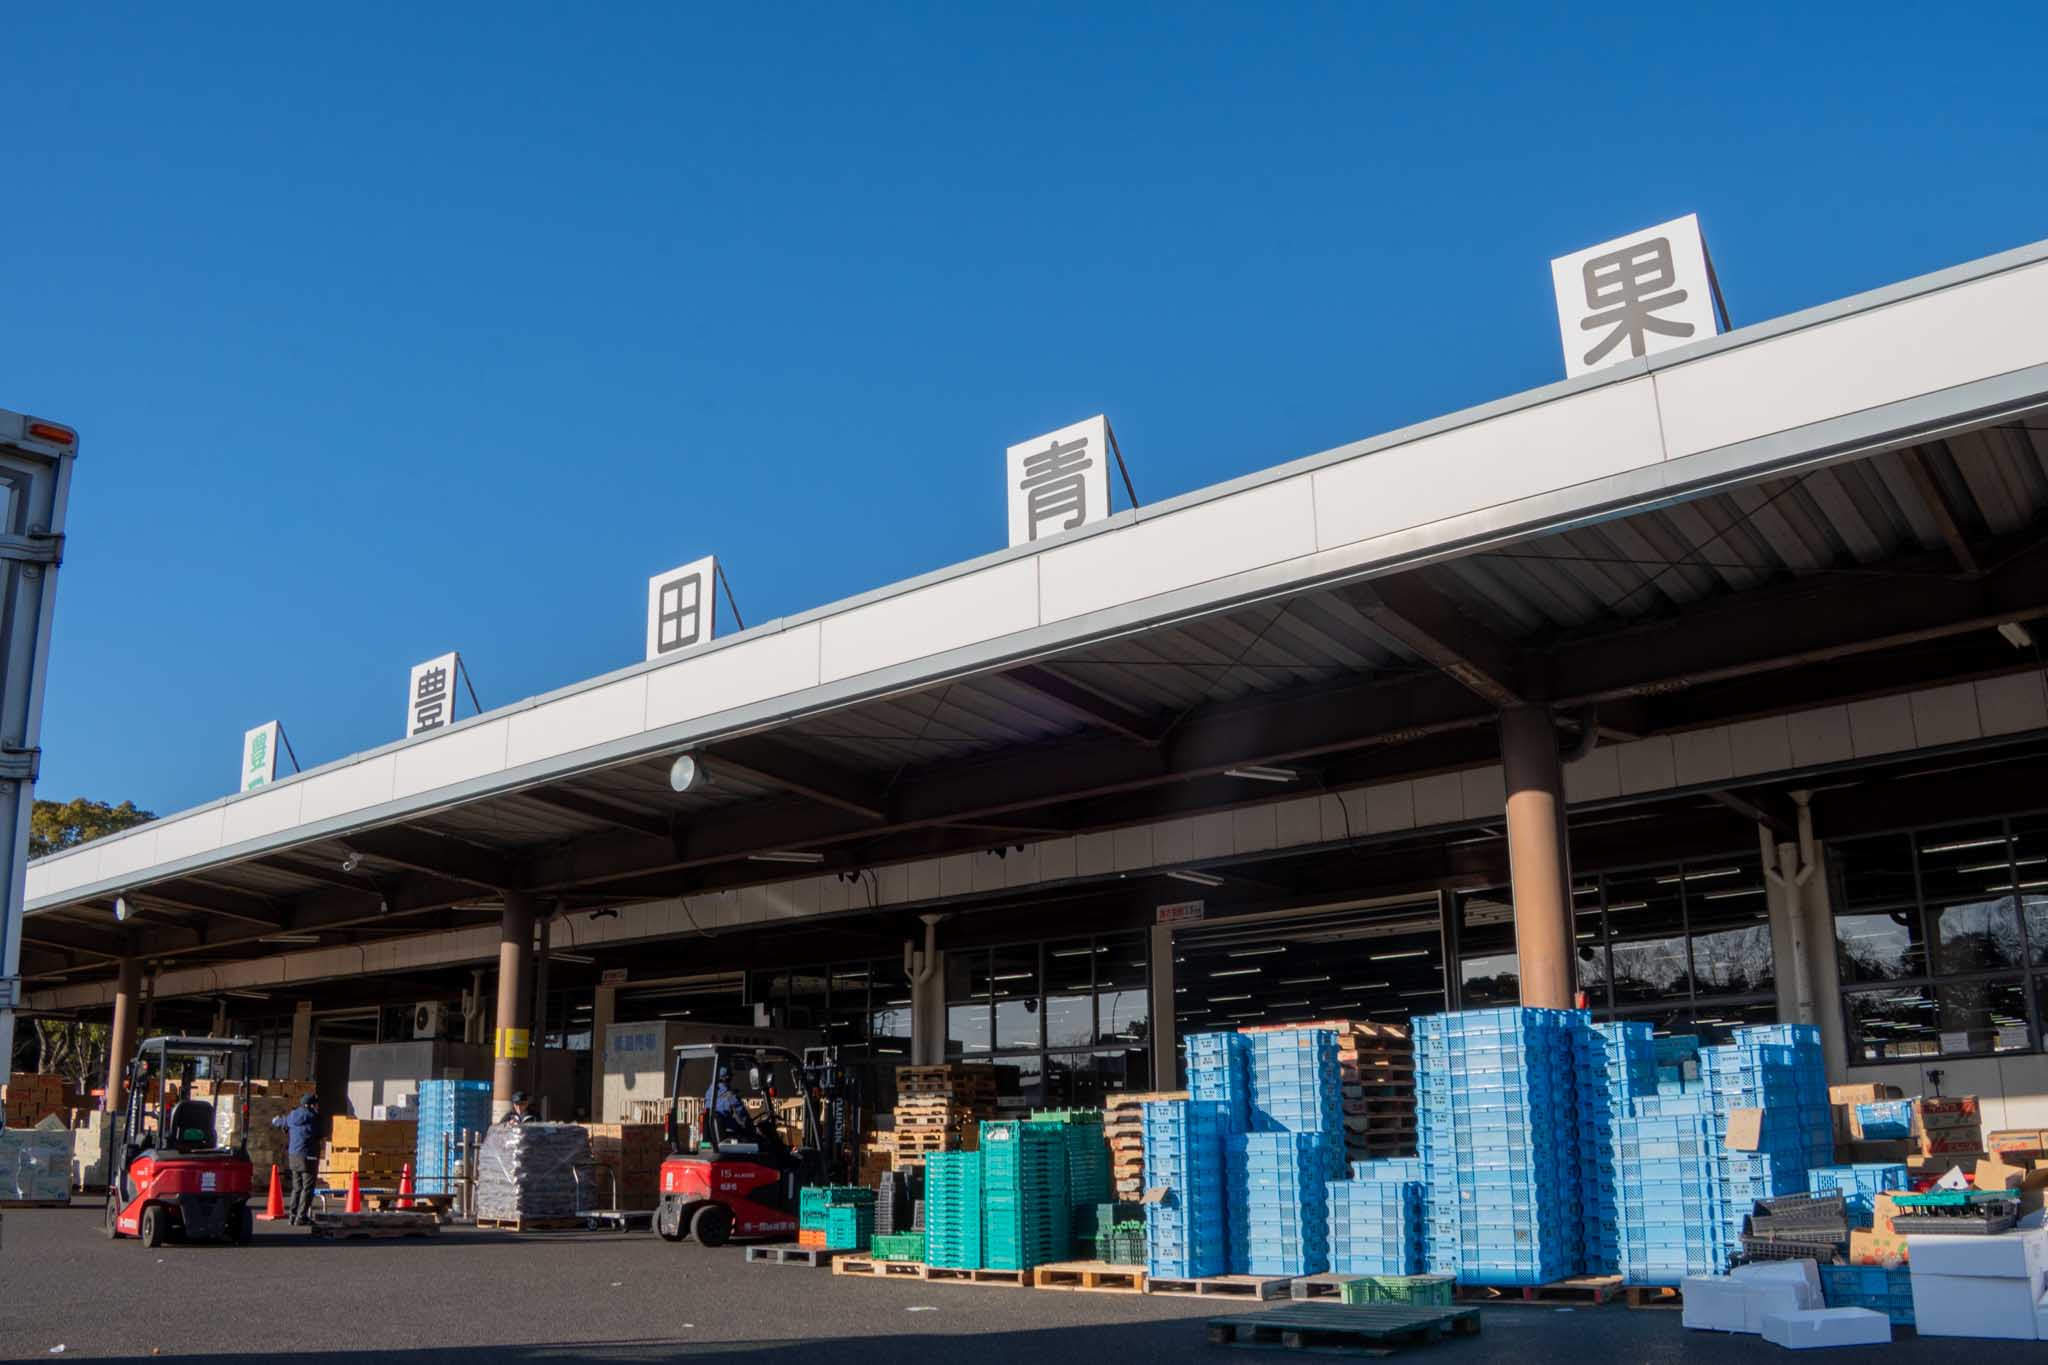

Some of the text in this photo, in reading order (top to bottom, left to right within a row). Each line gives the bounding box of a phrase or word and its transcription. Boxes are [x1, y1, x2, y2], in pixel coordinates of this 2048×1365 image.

[413, 237, 1695, 736] 豊 田 青 果
